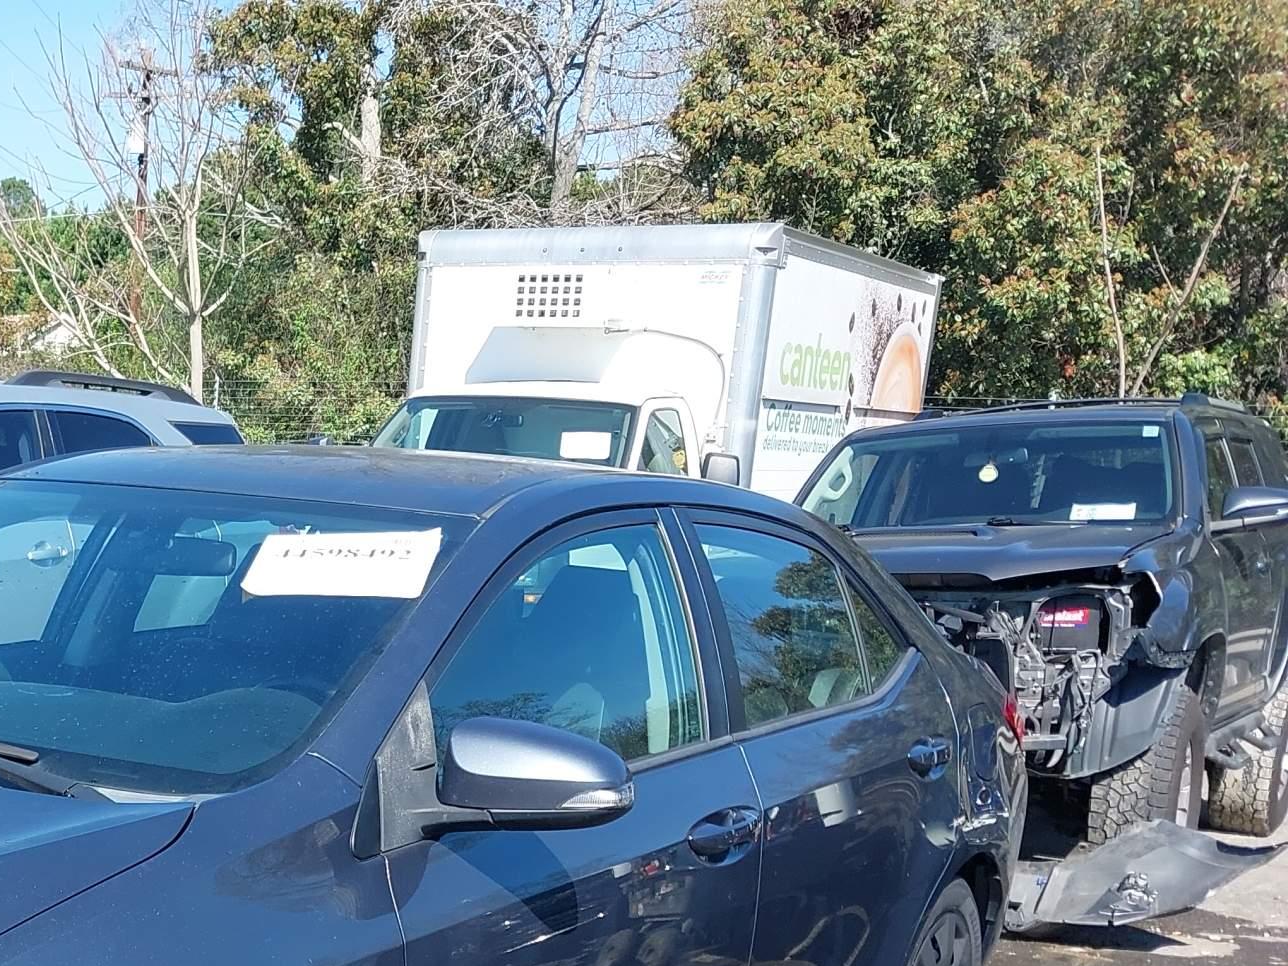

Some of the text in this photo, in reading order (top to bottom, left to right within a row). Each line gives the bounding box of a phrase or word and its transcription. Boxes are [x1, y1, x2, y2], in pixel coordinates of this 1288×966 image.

[780, 333, 851, 391] canteen
[767, 402, 847, 438] Coffee moments
[763, 434, 793, 451] delivered
